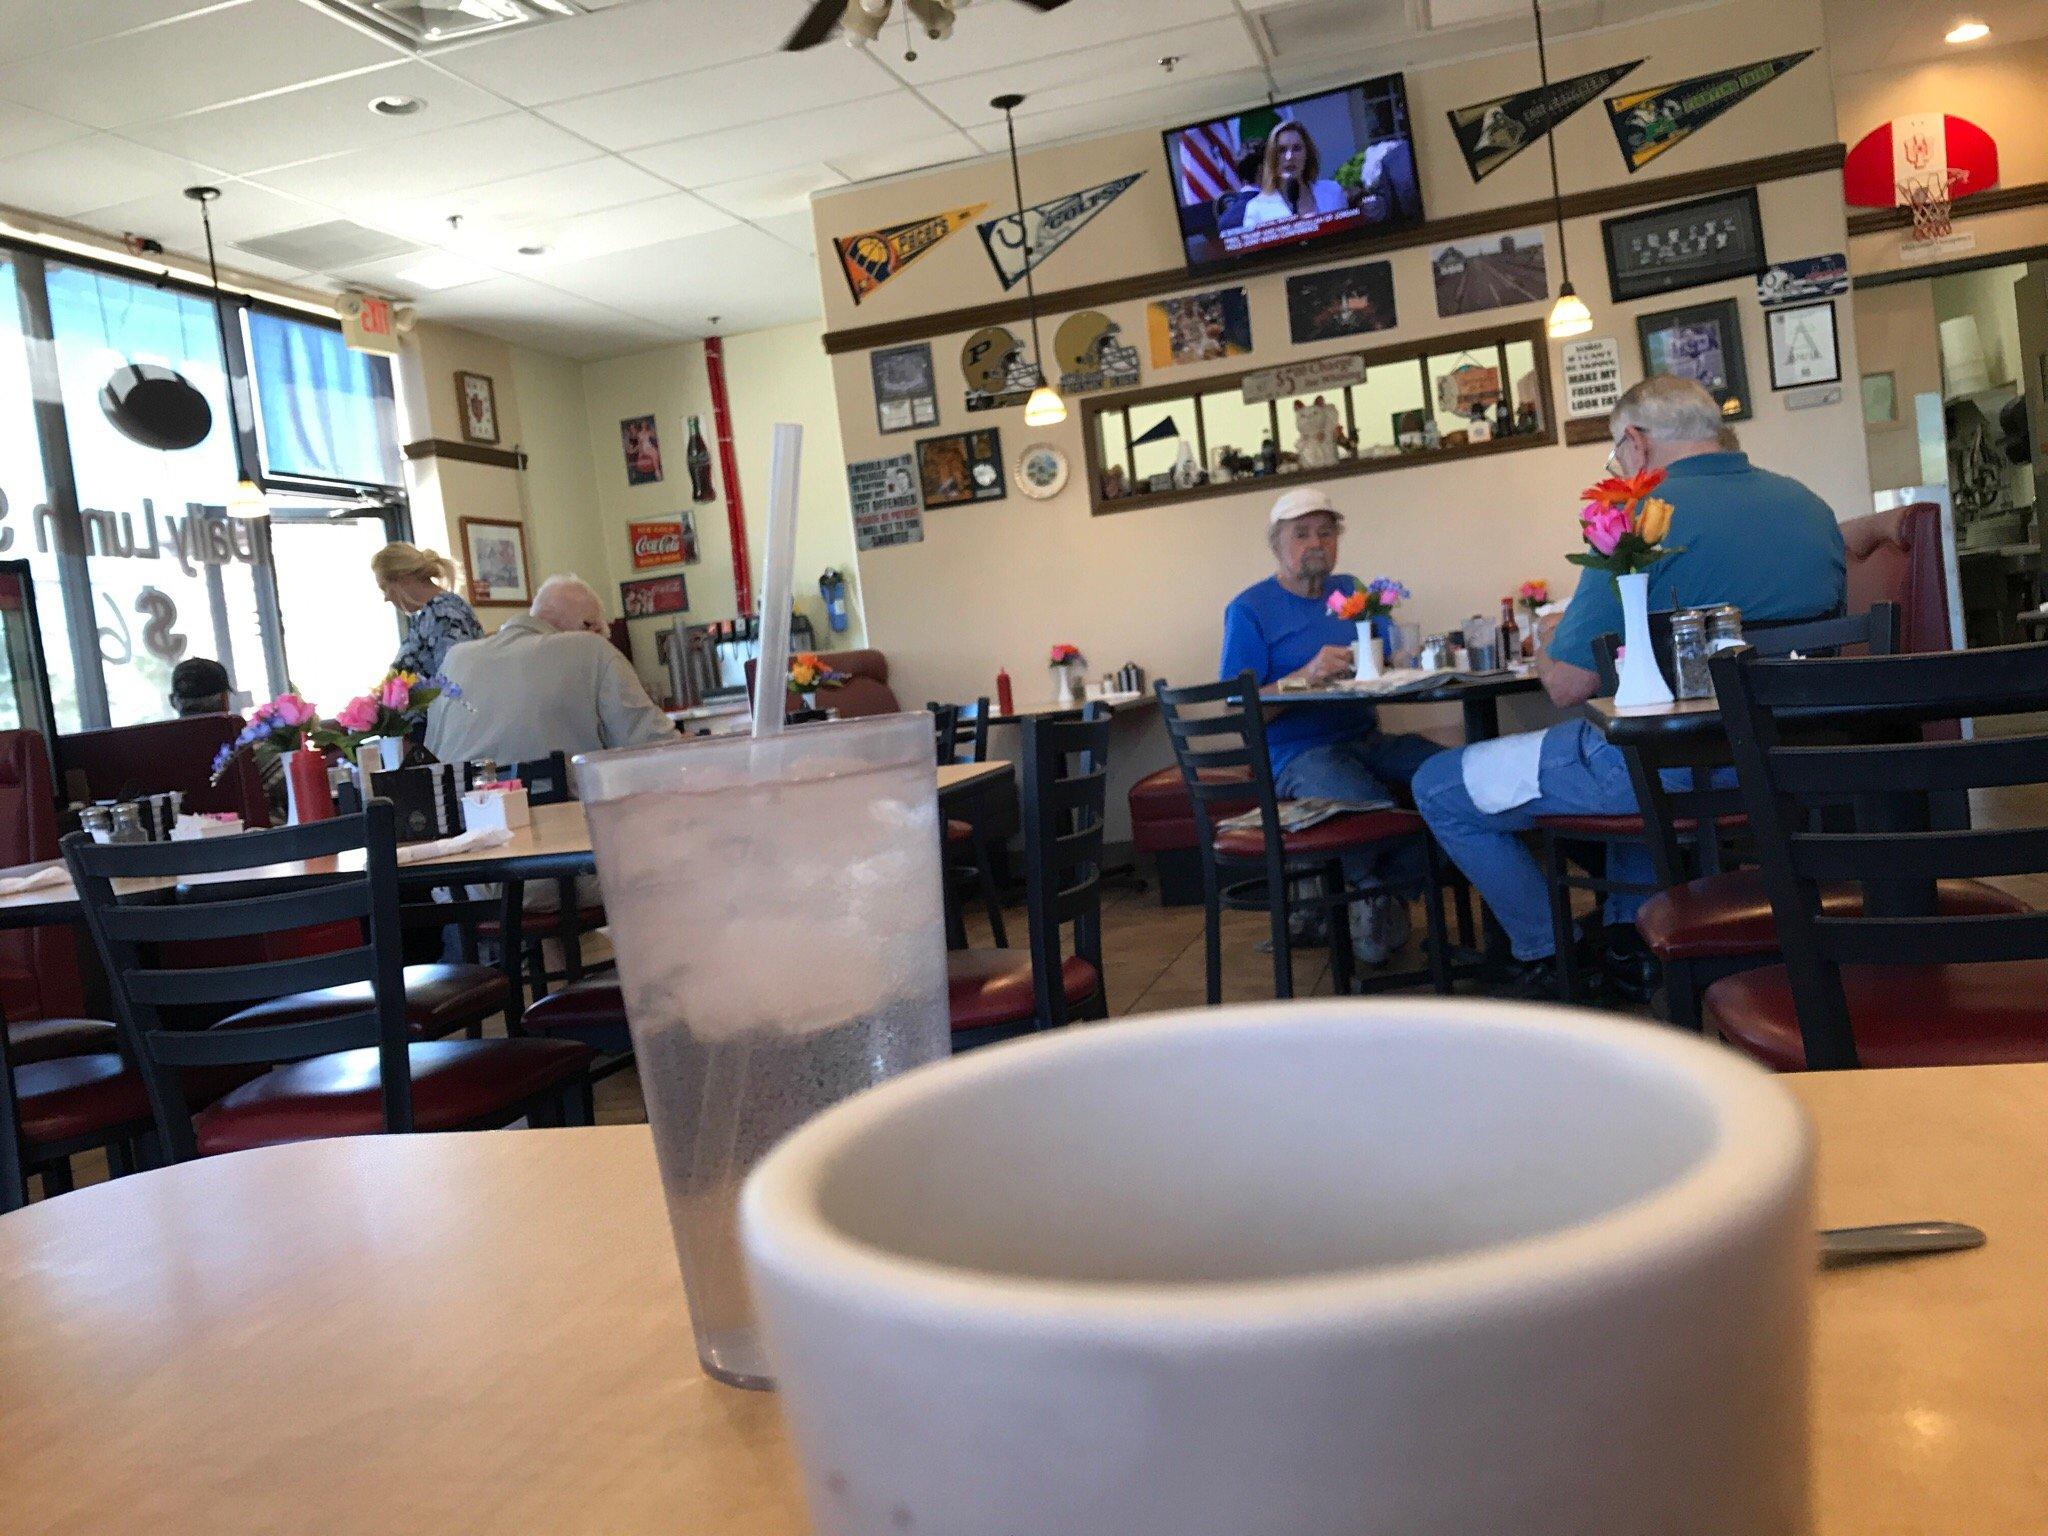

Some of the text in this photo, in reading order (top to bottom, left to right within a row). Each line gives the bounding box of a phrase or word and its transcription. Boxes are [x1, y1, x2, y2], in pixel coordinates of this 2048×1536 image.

[968, 340, 992, 366] P
[1568, 369, 1617, 383] MAKE MY
[1571, 383, 1616, 396] FRIENDS
[1572, 399, 1598, 409] LOOK
